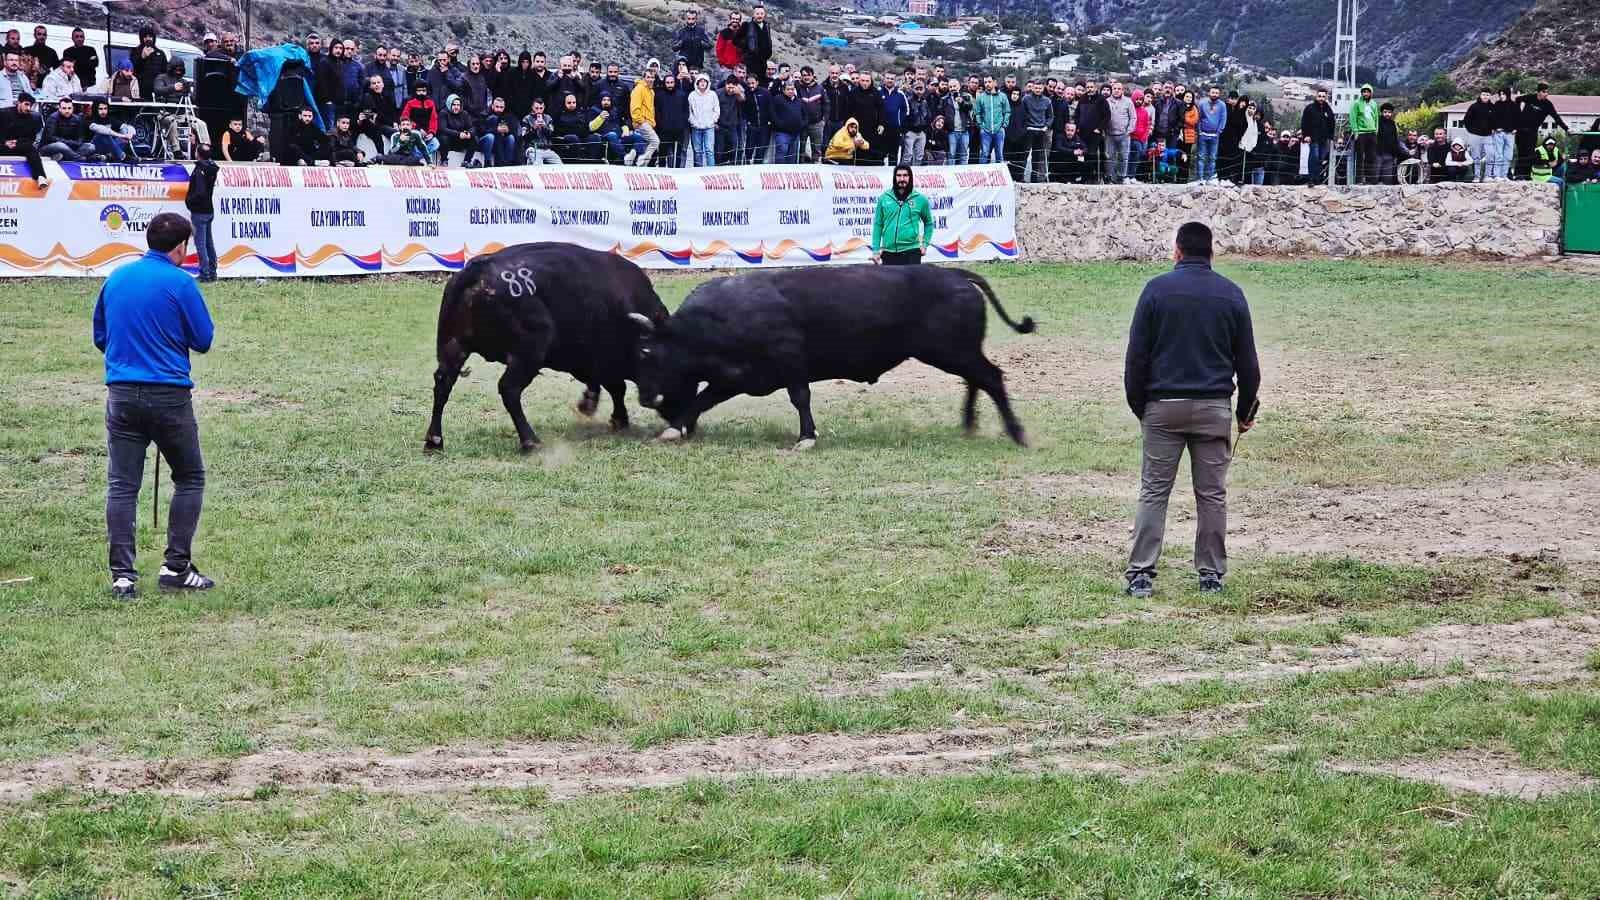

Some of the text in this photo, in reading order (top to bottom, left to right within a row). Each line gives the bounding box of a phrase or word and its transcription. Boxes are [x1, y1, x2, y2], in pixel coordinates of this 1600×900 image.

[221, 193, 281, 215] AK PARTİ ARTVİN
[342, 210, 366, 226] PETROL
[490, 205, 508, 225] KÖYÜ
[508, 208, 537, 225] MUHTARI
[702, 208, 749, 226] HAKAN ECZANESİ
[126, 221, 150, 231] YILM
[232, 217, 271, 240] İL BAŞKANI
[500, 267, 537, 297] 88
